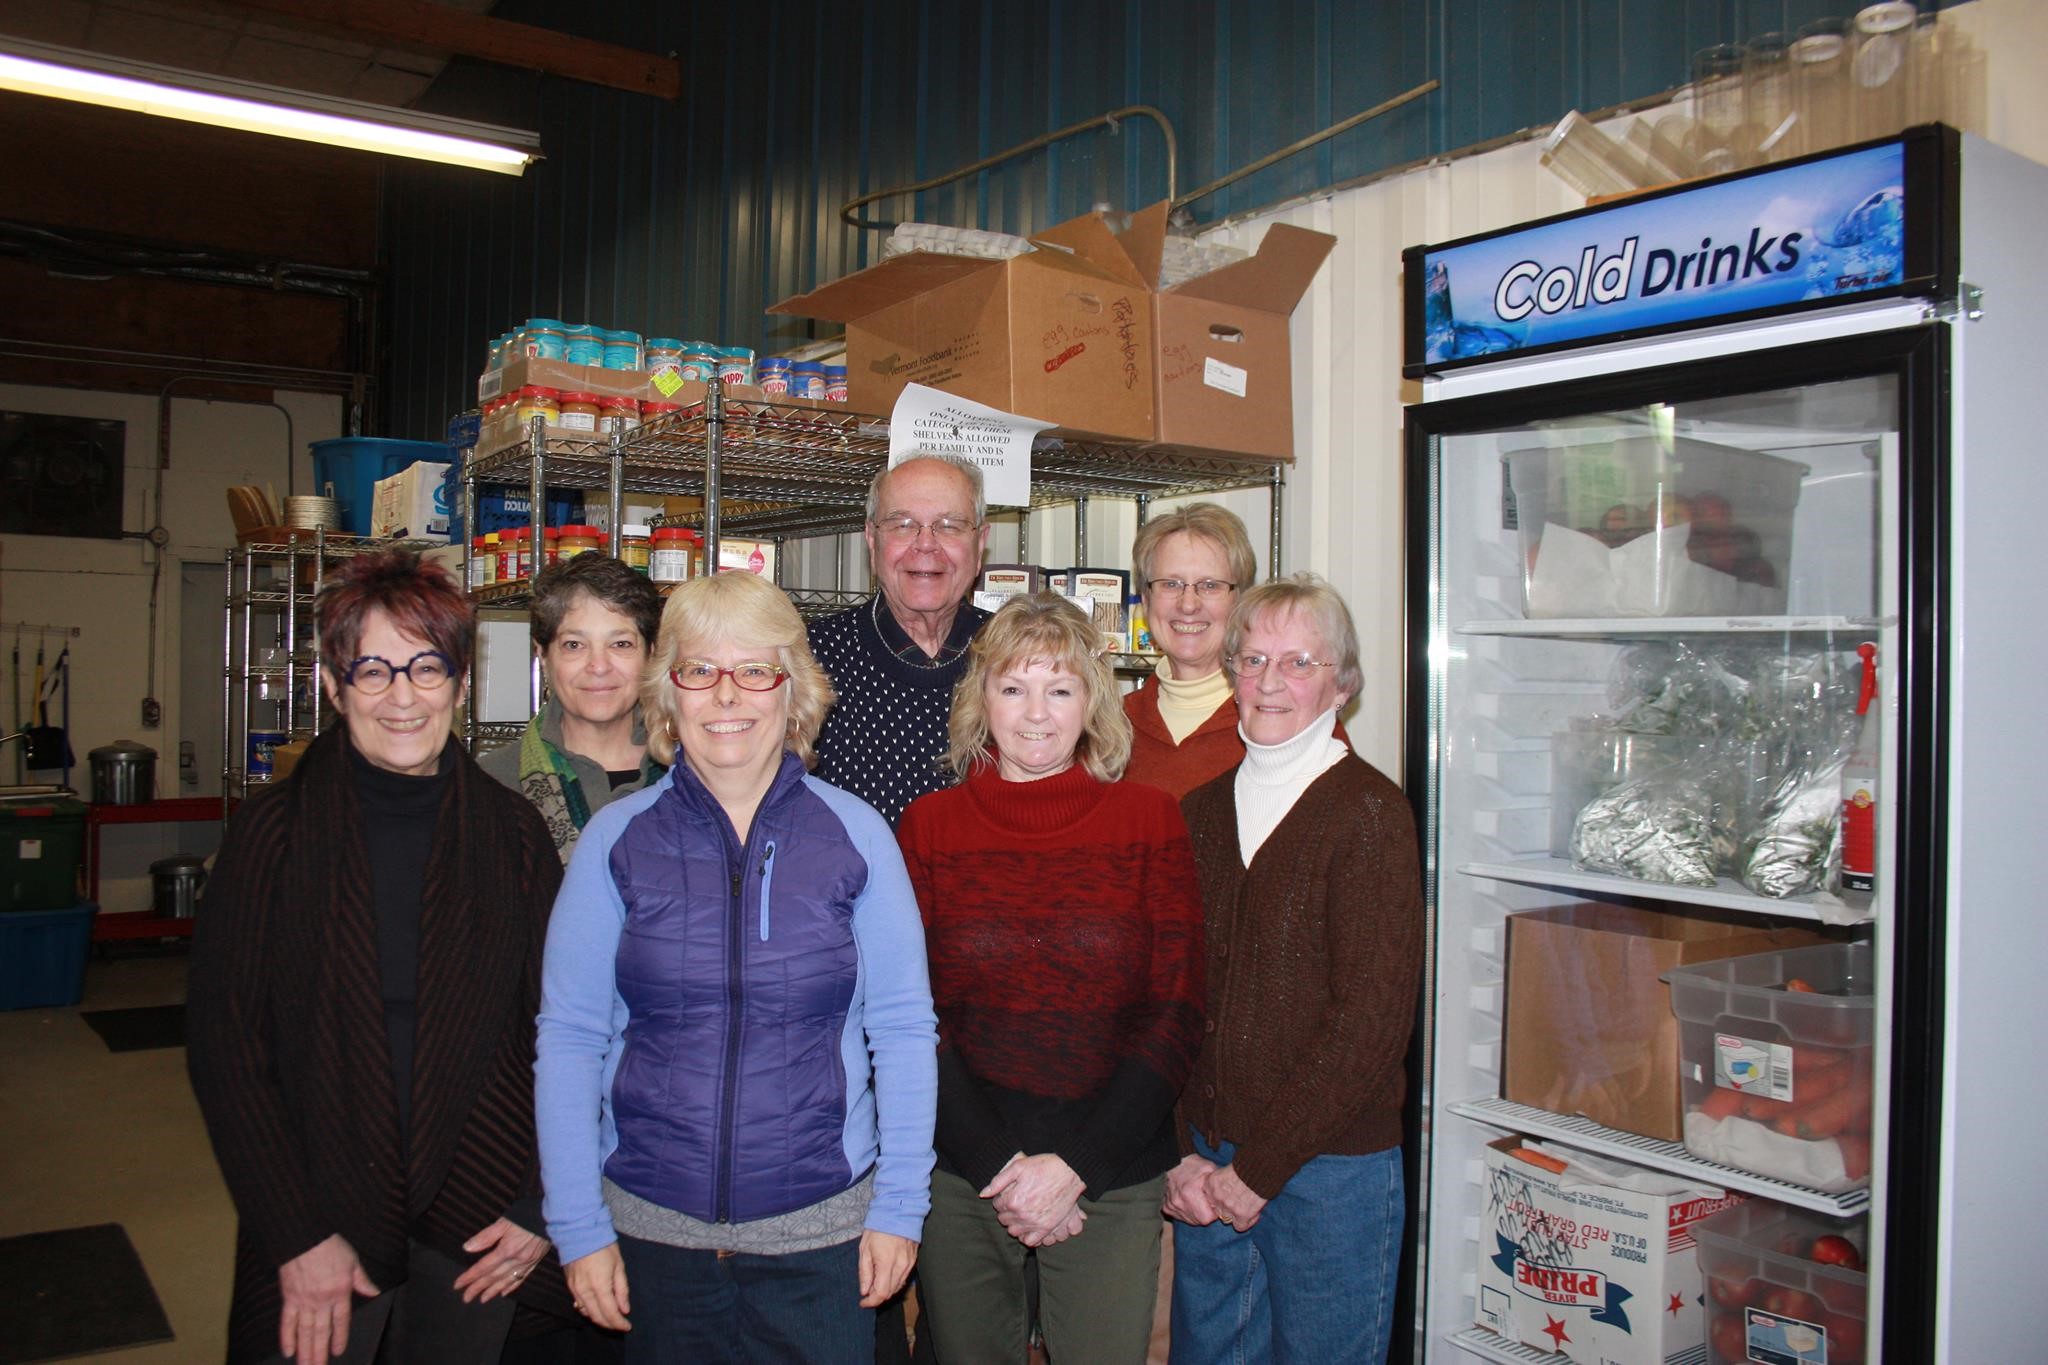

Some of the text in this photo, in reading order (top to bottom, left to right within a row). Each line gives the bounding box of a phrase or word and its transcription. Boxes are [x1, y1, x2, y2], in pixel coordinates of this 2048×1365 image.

[1494, 226, 1803, 322] Cold Drinks
[889, 360, 918, 376] Vermont
[919, 347, 952, 367] Foodbank
[914, 418, 963, 430] CATEGORY
[984, 426, 1012, 435] THESE
[912, 430, 953, 440] SHELVES
[965, 434, 1011, 444] ALLOWED
[919, 442, 1004, 455] PER FAMILY AND IS
[982, 457, 1004, 466] ITEM
[1507, 1199, 1610, 1242] RED GRAPEFRUIT
[1602, 1204, 1649, 1221] DISTRIBUTED
[1556, 1231, 1589, 1250] STAR
[1613, 1231, 1647, 1249] OF U.S.A.
[1610, 1245, 1647, 1263] PRODUCE
[1516, 1261, 1599, 1297] PRIDE
[1544, 1291, 1577, 1304] RIVER
